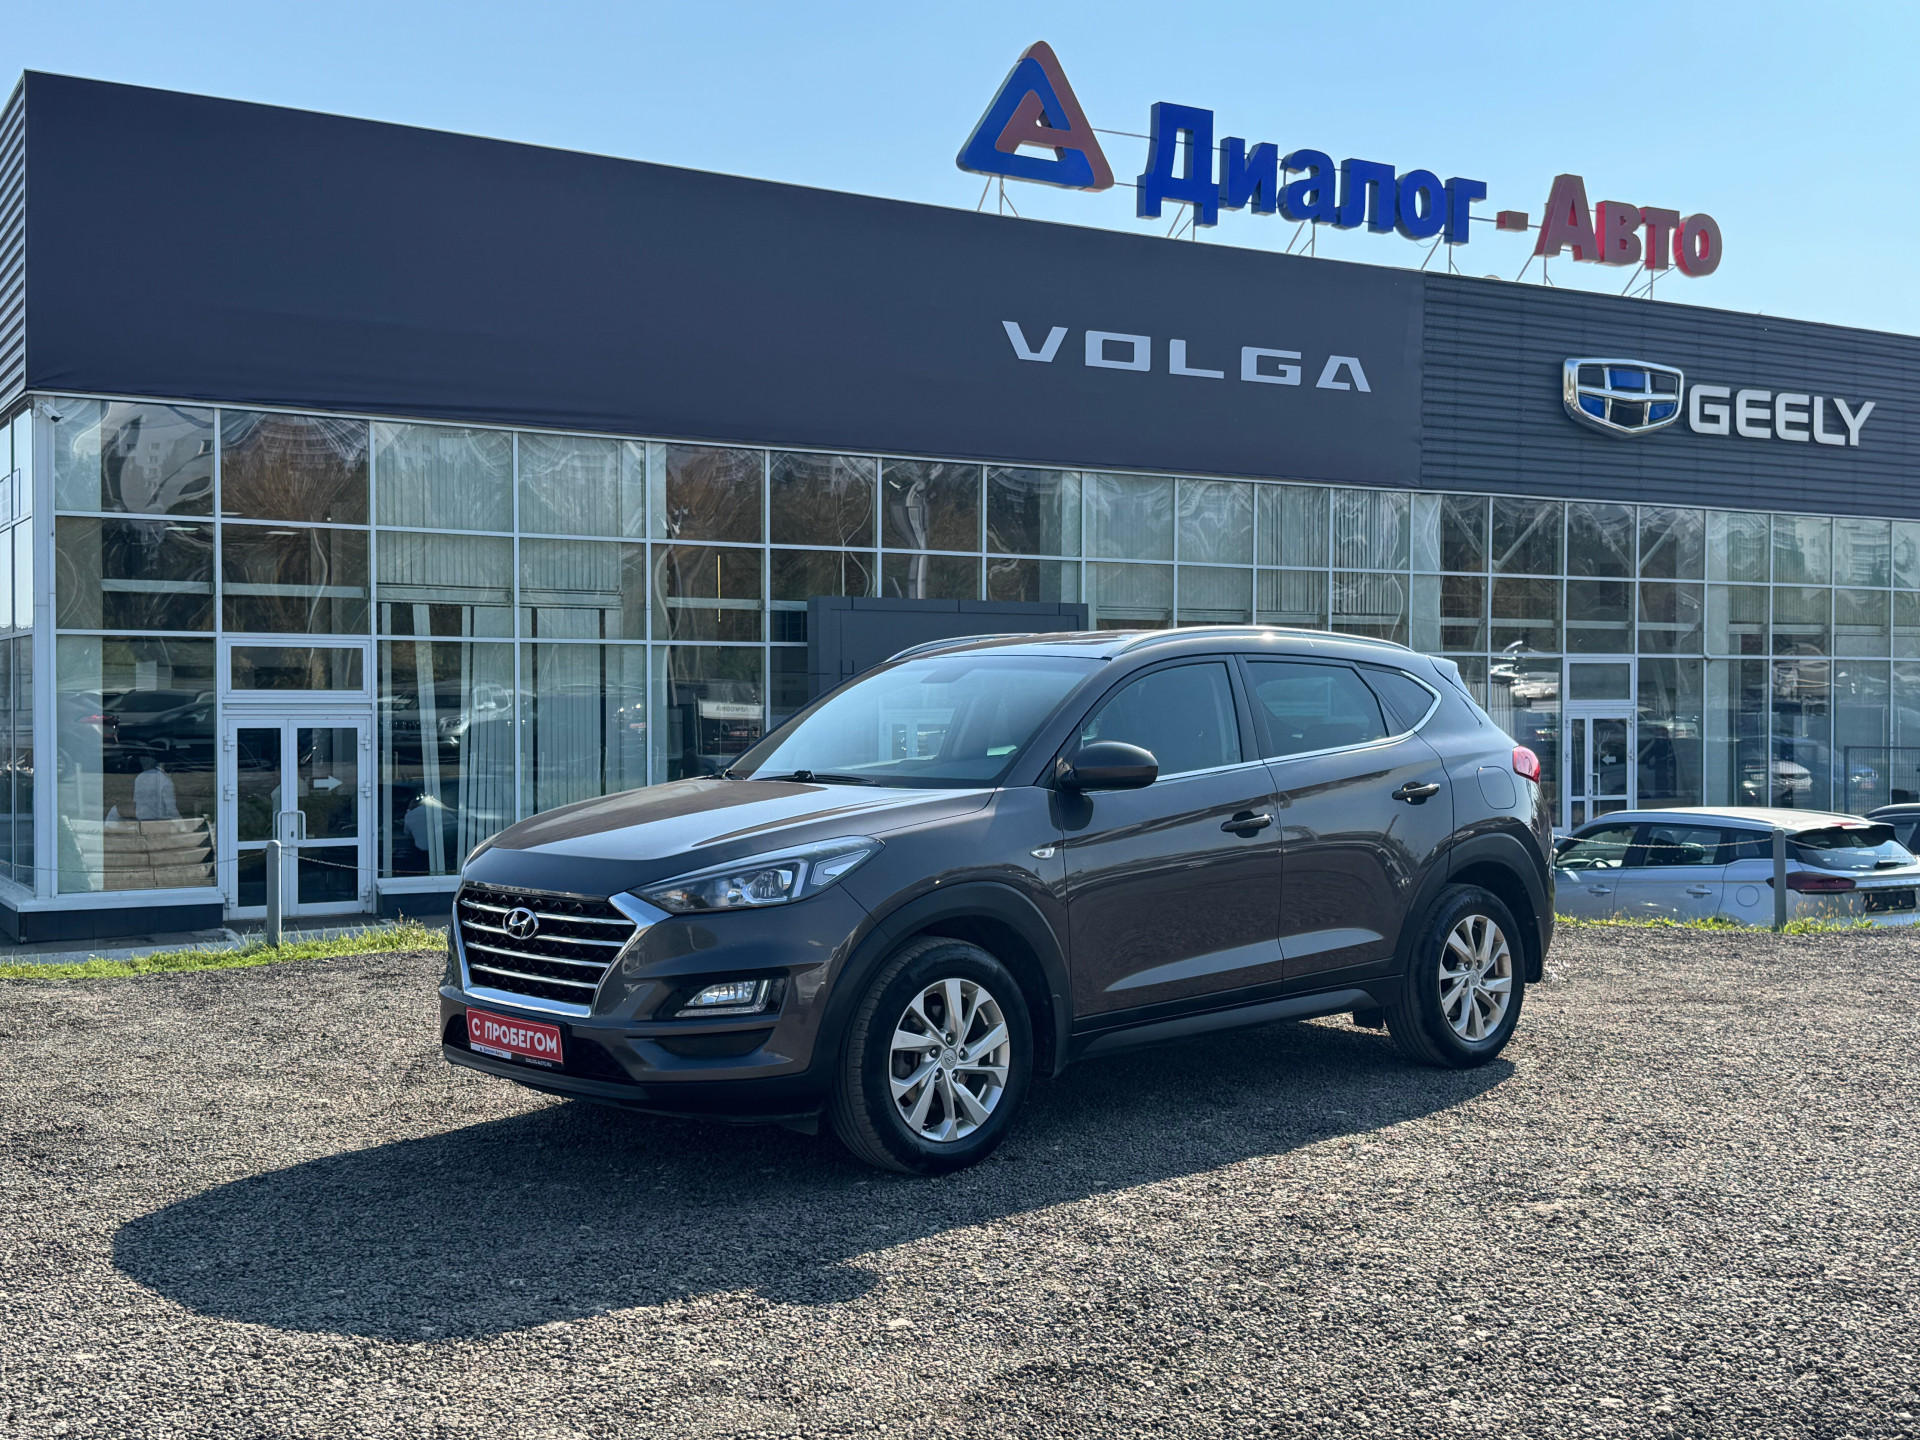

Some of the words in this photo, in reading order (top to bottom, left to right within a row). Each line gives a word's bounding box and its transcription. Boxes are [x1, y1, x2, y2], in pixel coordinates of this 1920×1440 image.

[1001, 320, 1372, 393] VOLGA
[1689, 383, 1877, 447] GEELY
[472, 1018, 481, 1036] С
[485, 1021, 557, 1054] ПРОБЕГОМ
